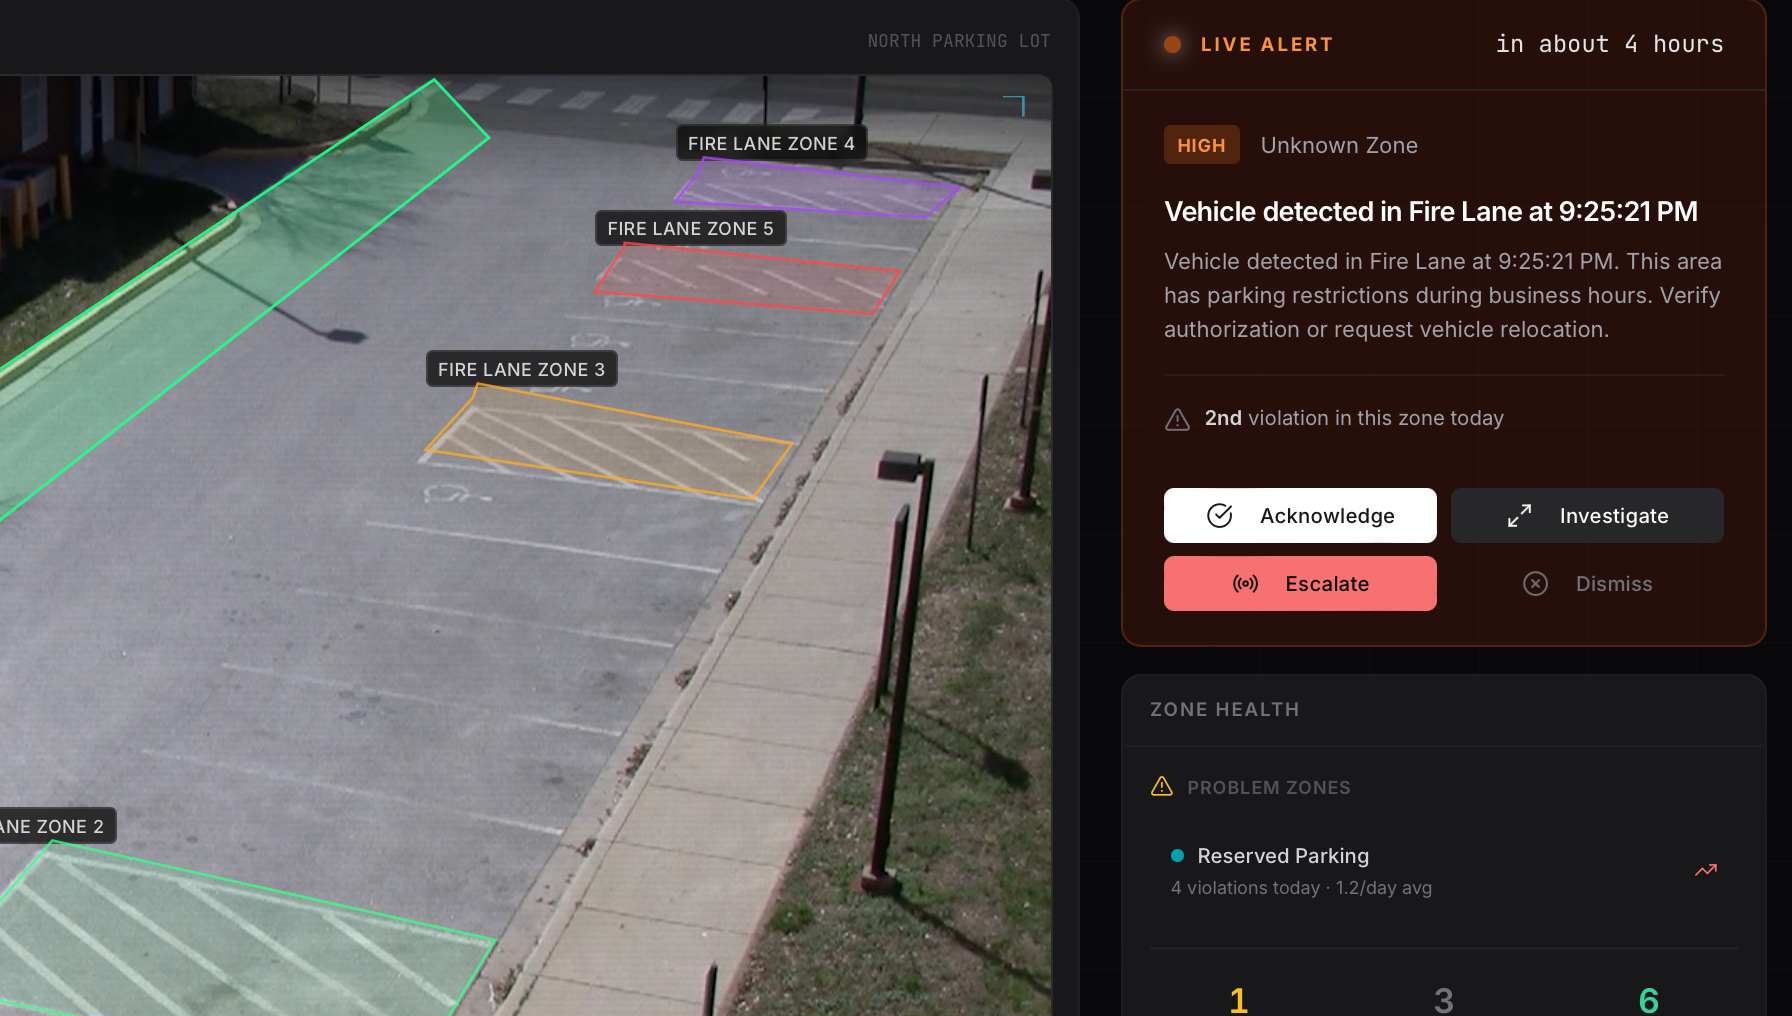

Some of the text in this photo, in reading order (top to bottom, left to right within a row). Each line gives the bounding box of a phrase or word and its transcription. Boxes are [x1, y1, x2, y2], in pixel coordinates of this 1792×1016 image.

[868, 32, 1051, 49] NORTH PARKING LOT
[1201, 36, 1333, 52] LIVE ALERT
[1496, 33, 1723, 53] in about 4 hours
[1177, 138, 1226, 153] HIGH
[1261, 135, 1419, 154] Unknown Zone
[1164, 199, 1698, 222] Vehicle detected in Fire Lane at 9:25:21 PM
[1164, 251, 1722, 270] Vehicle detected in Fire Lane at 9:25:21 PM. This area
[1164, 285, 1721, 309] has parking restrictions during business hours. Verify
[1164, 319, 1609, 343] authorization or request vehicle relocation.
[1205, 409, 1504, 430] 2nd violation in this zone today
[1260, 507, 1395, 528] Acknowledge
[1560, 507, 1669, 528] Investigate
[1286, 575, 1370, 592] Escalate
[1576, 575, 1653, 592] Dismiss
[1150, 701, 1299, 717] ZONE HEALTH
[1187, 780, 1351, 795] PROBLEM ZONES
[1198, 847, 1369, 868] Reserved Parking
[1171, 880, 1182, 895] 4
[1187, 879, 1268, 895] violations
[1272, 880, 1321, 899] today
[1335, 879, 1397, 899] 1.2/day
[1401, 883, 1432, 899] avg
[1230, 987, 1249, 1014] 1
[1434, 987, 1454, 1014] 3
[1639, 987, 1659, 1014] 6
